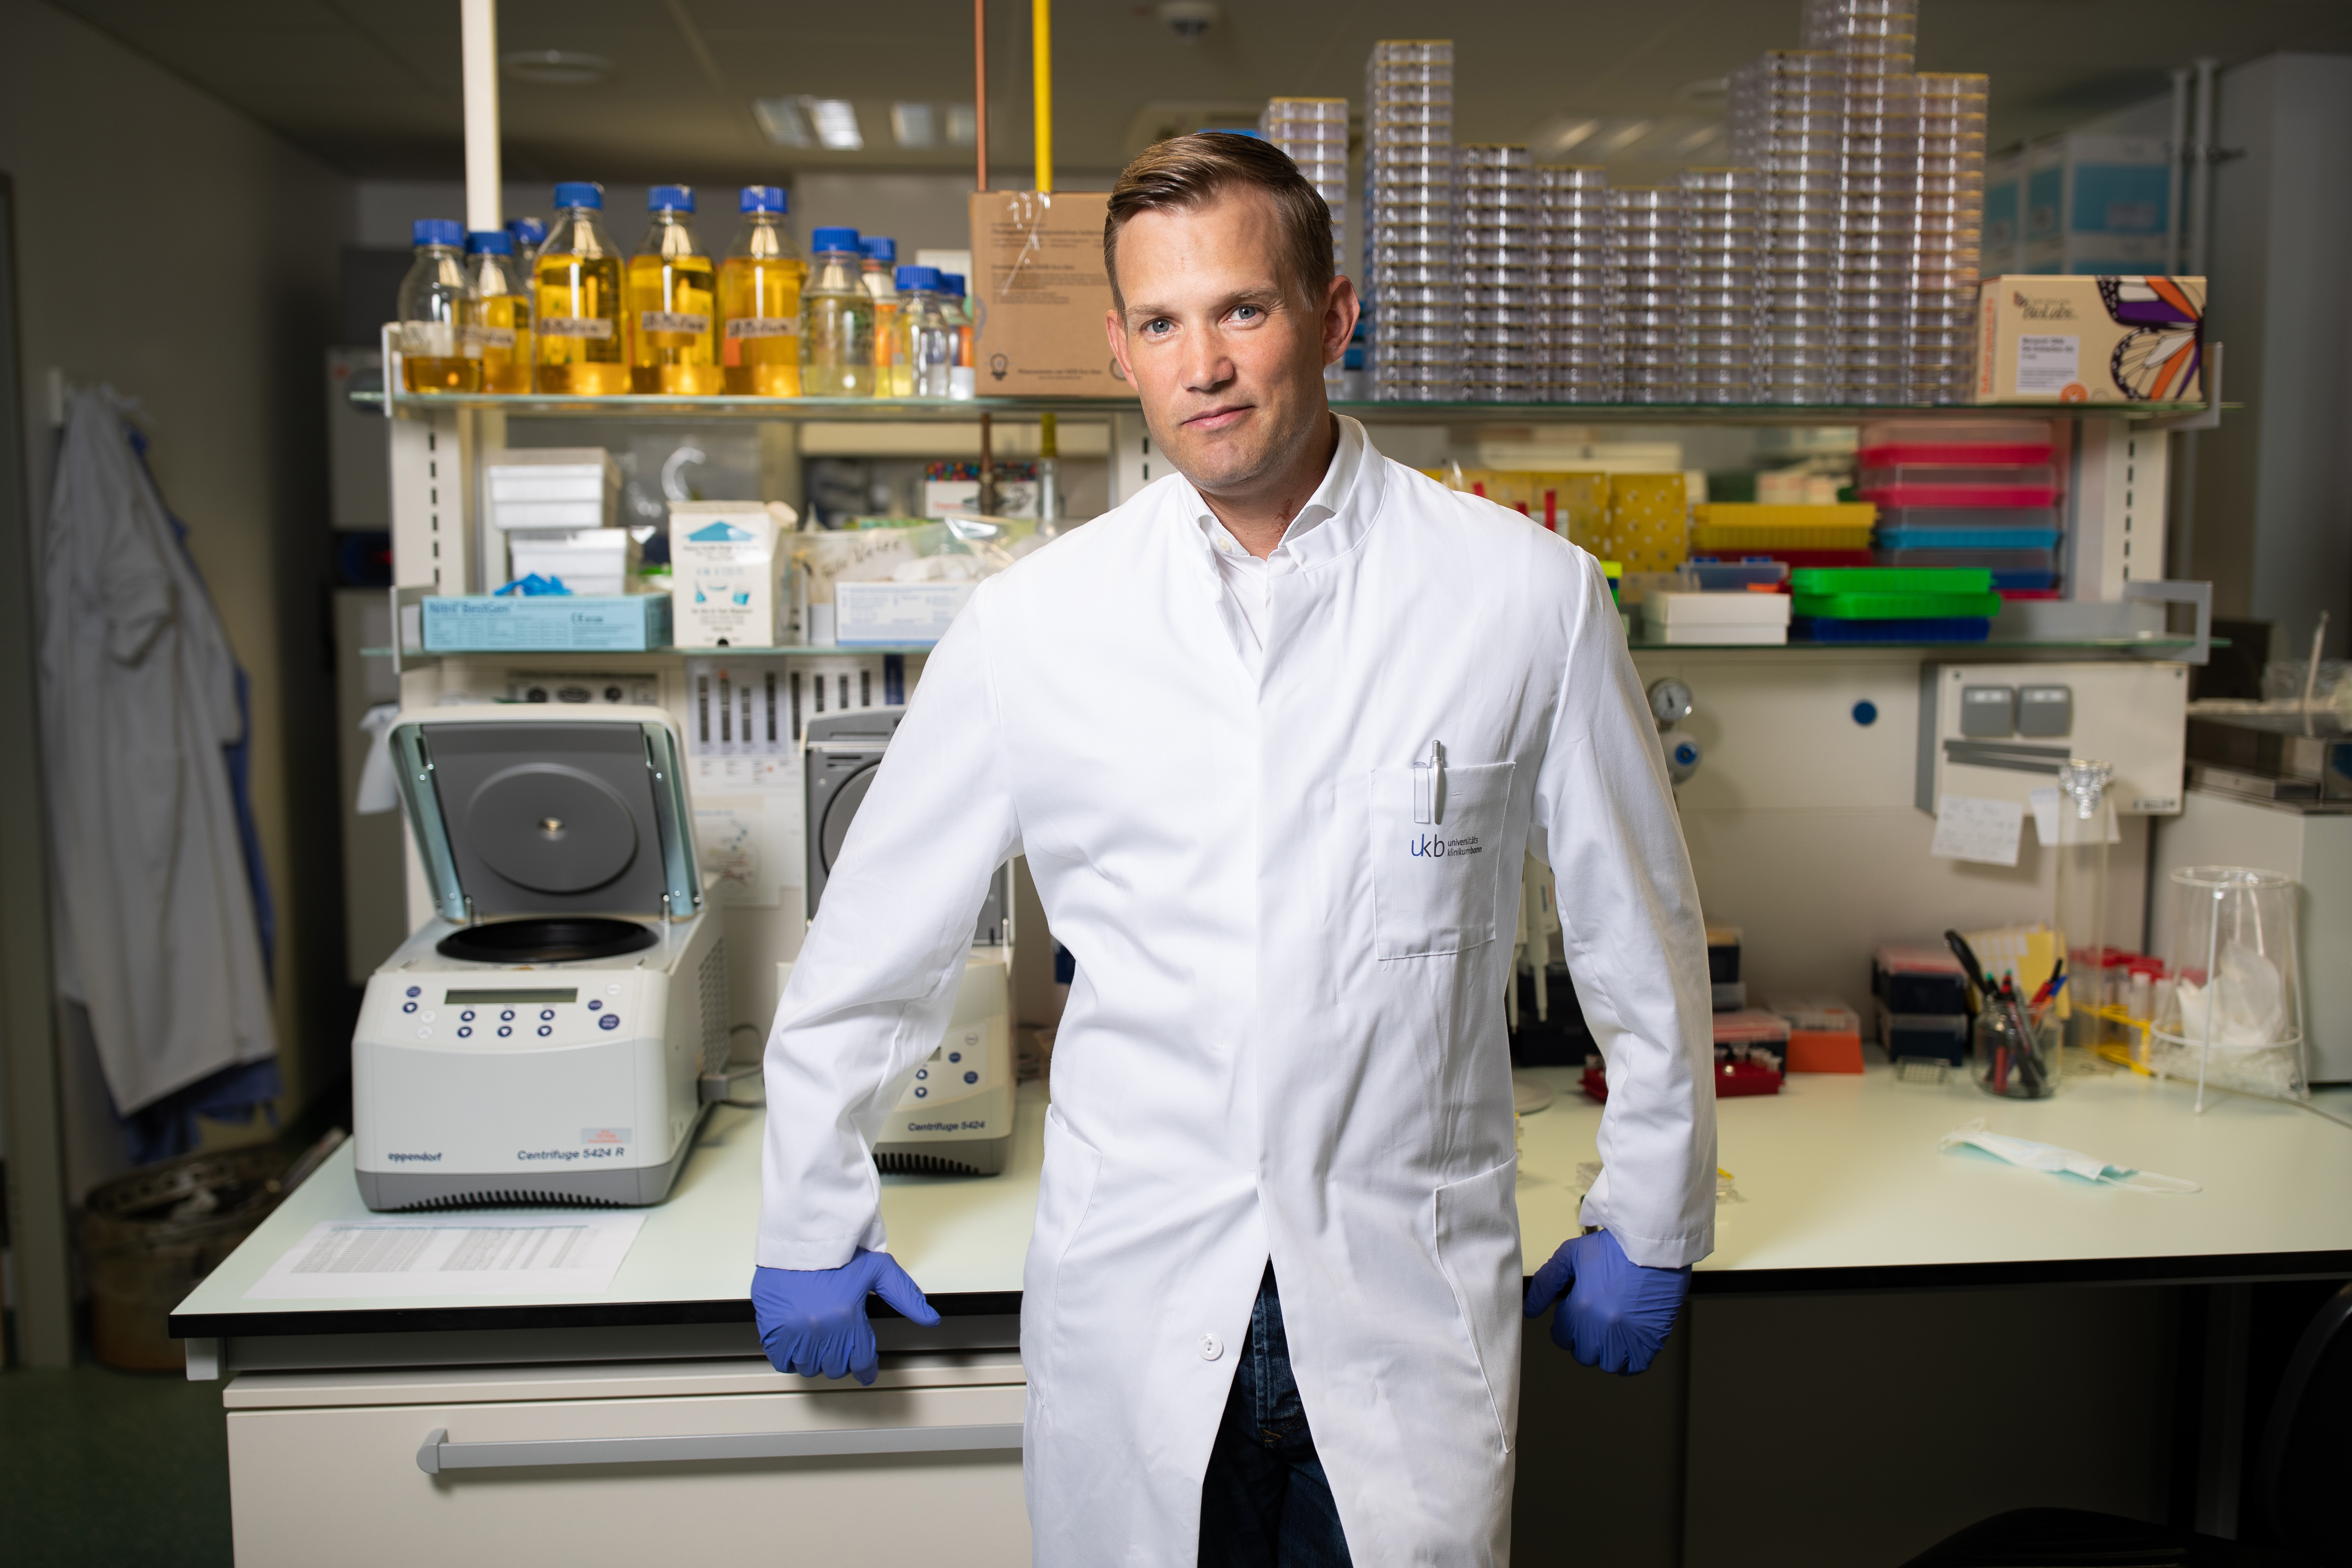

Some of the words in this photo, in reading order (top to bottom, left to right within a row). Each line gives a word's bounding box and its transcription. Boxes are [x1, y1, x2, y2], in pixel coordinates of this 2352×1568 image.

[1412, 833, 1445, 857] ukb
[1448, 836, 1479, 847] universitäts
[1447, 846, 1482, 856] klinikumbonn
[908, 1122, 959, 1132] Centrifuge
[961, 1120, 985, 1130] 5424
[388, 1152, 442, 1163] eppendorf
[518, 1150, 579, 1161] Centrifuge
[583, 1148, 611, 1158] 5424
[615, 1147, 625, 1156] R
